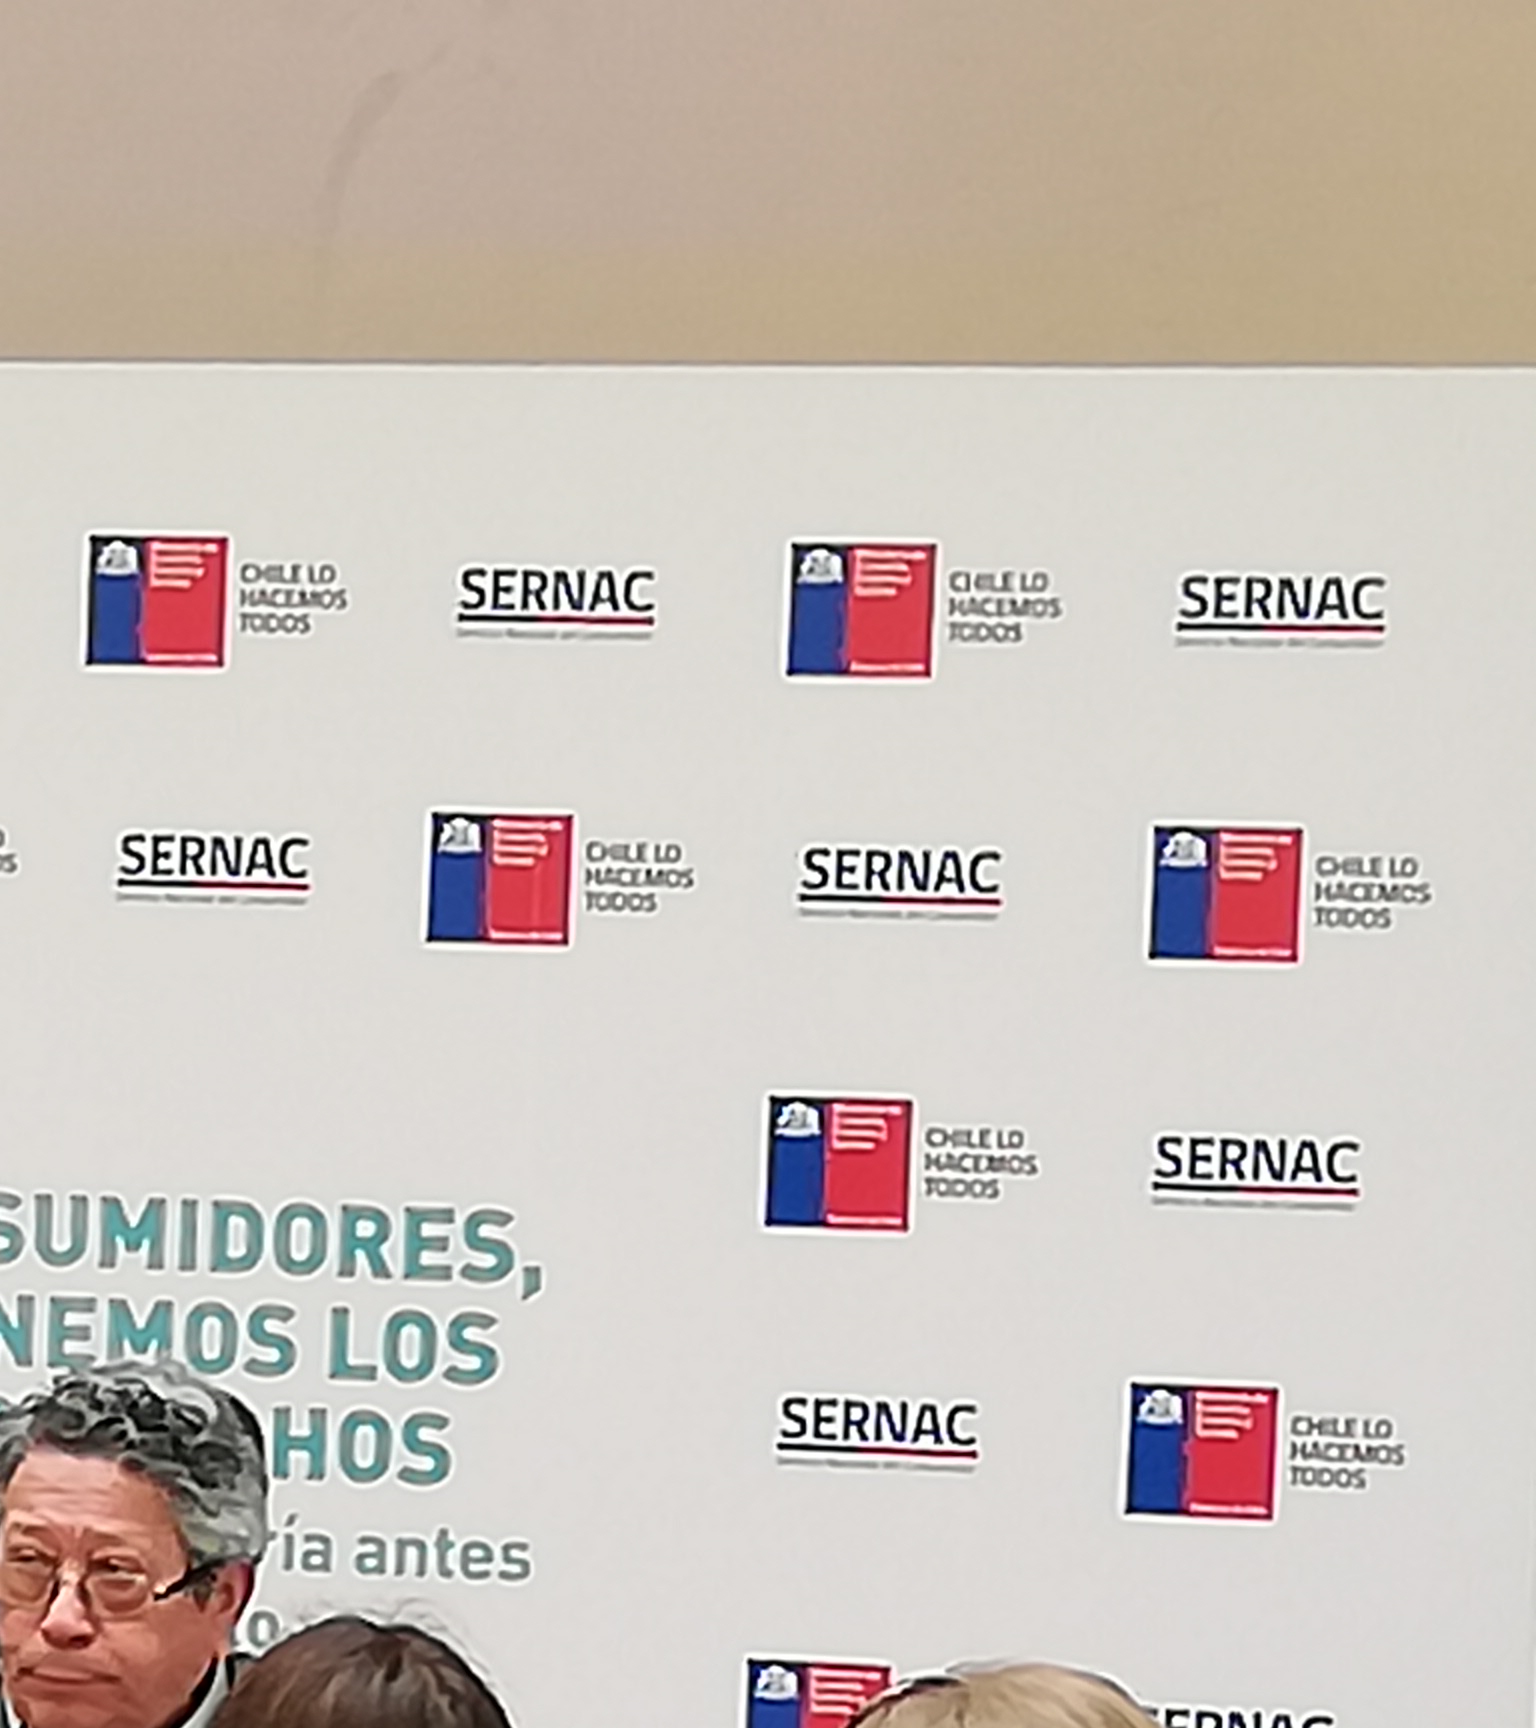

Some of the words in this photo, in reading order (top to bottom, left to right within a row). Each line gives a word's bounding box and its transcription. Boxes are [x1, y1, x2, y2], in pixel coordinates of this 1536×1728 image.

[457, 568, 655, 613] SERNAC
[1178, 575, 1386, 620] SERNAC
[118, 833, 310, 879] SERNAC
[800, 847, 1002, 894] SERNAC
[1153, 1136, 1360, 1184] SERNAC
[328, 1306, 499, 1386] LOS
[779, 1397, 978, 1446] SERNAC
[355, 1528, 530, 1581] antes
